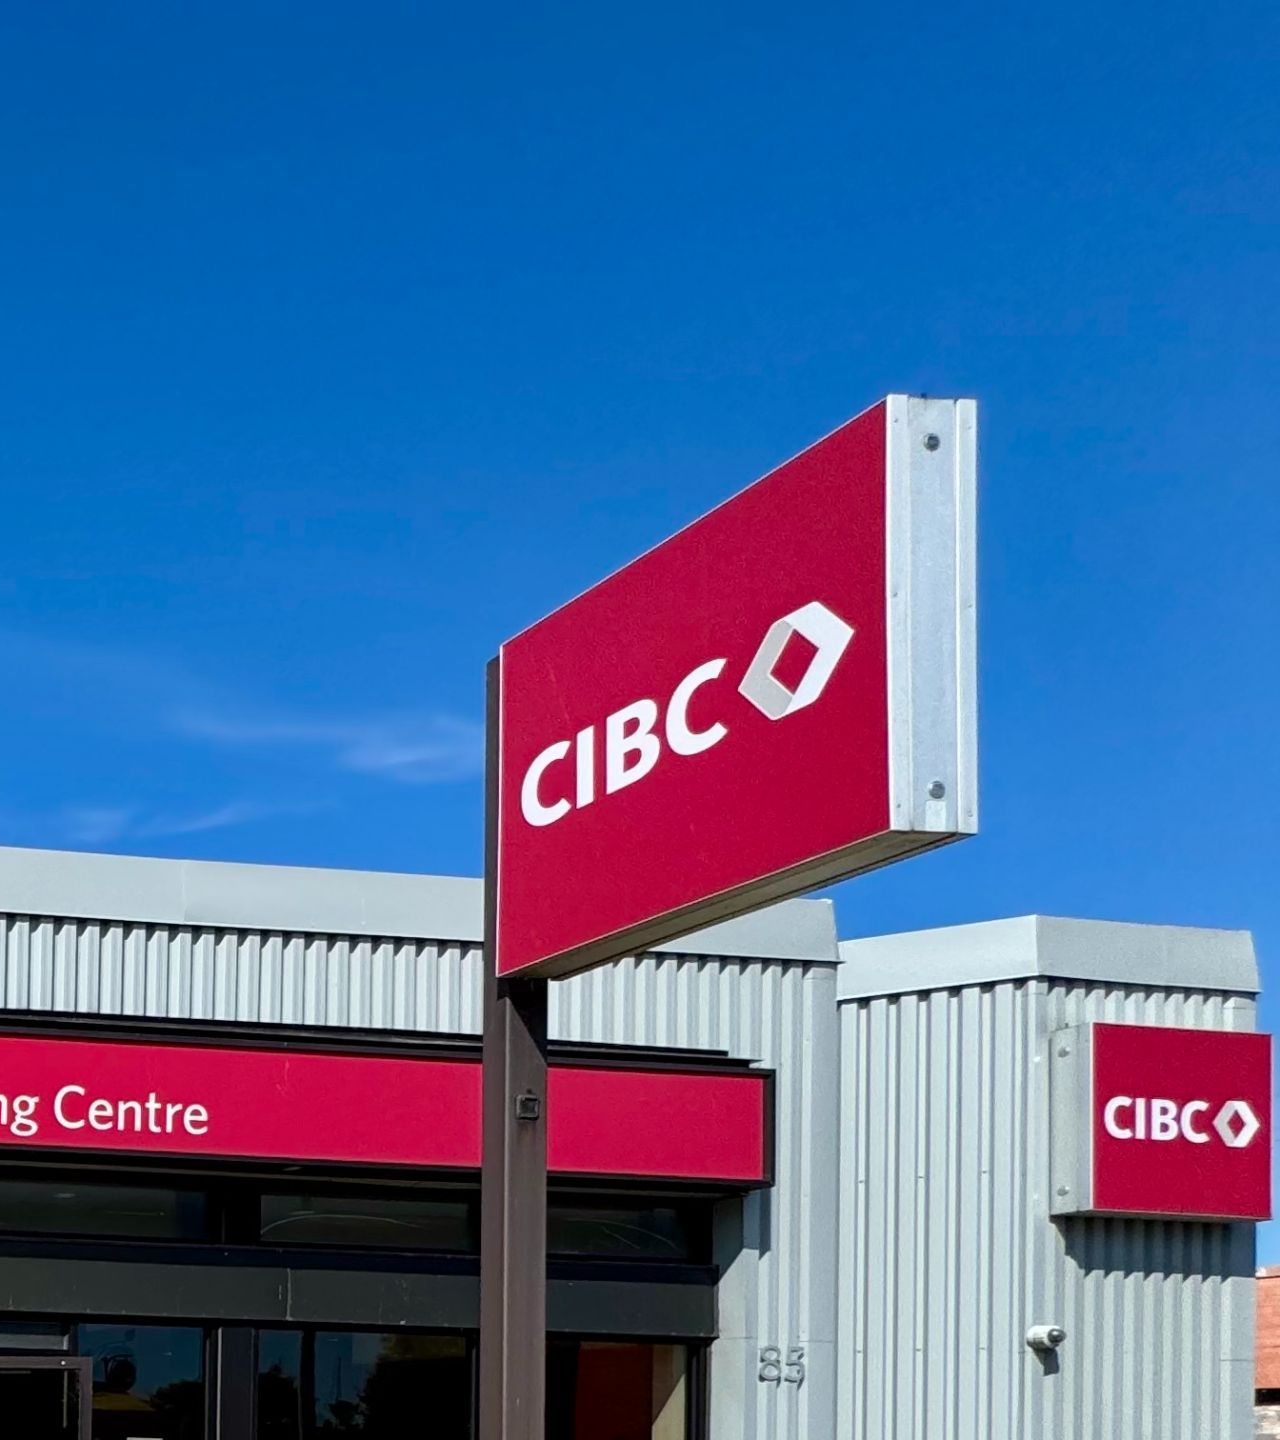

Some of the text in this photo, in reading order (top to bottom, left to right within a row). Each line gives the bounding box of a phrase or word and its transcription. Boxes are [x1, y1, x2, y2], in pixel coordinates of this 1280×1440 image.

[521, 658, 728, 826] CIBC
[53, 1085, 209, 1135] Centre
[1104, 1096, 1210, 1144] CIBC
